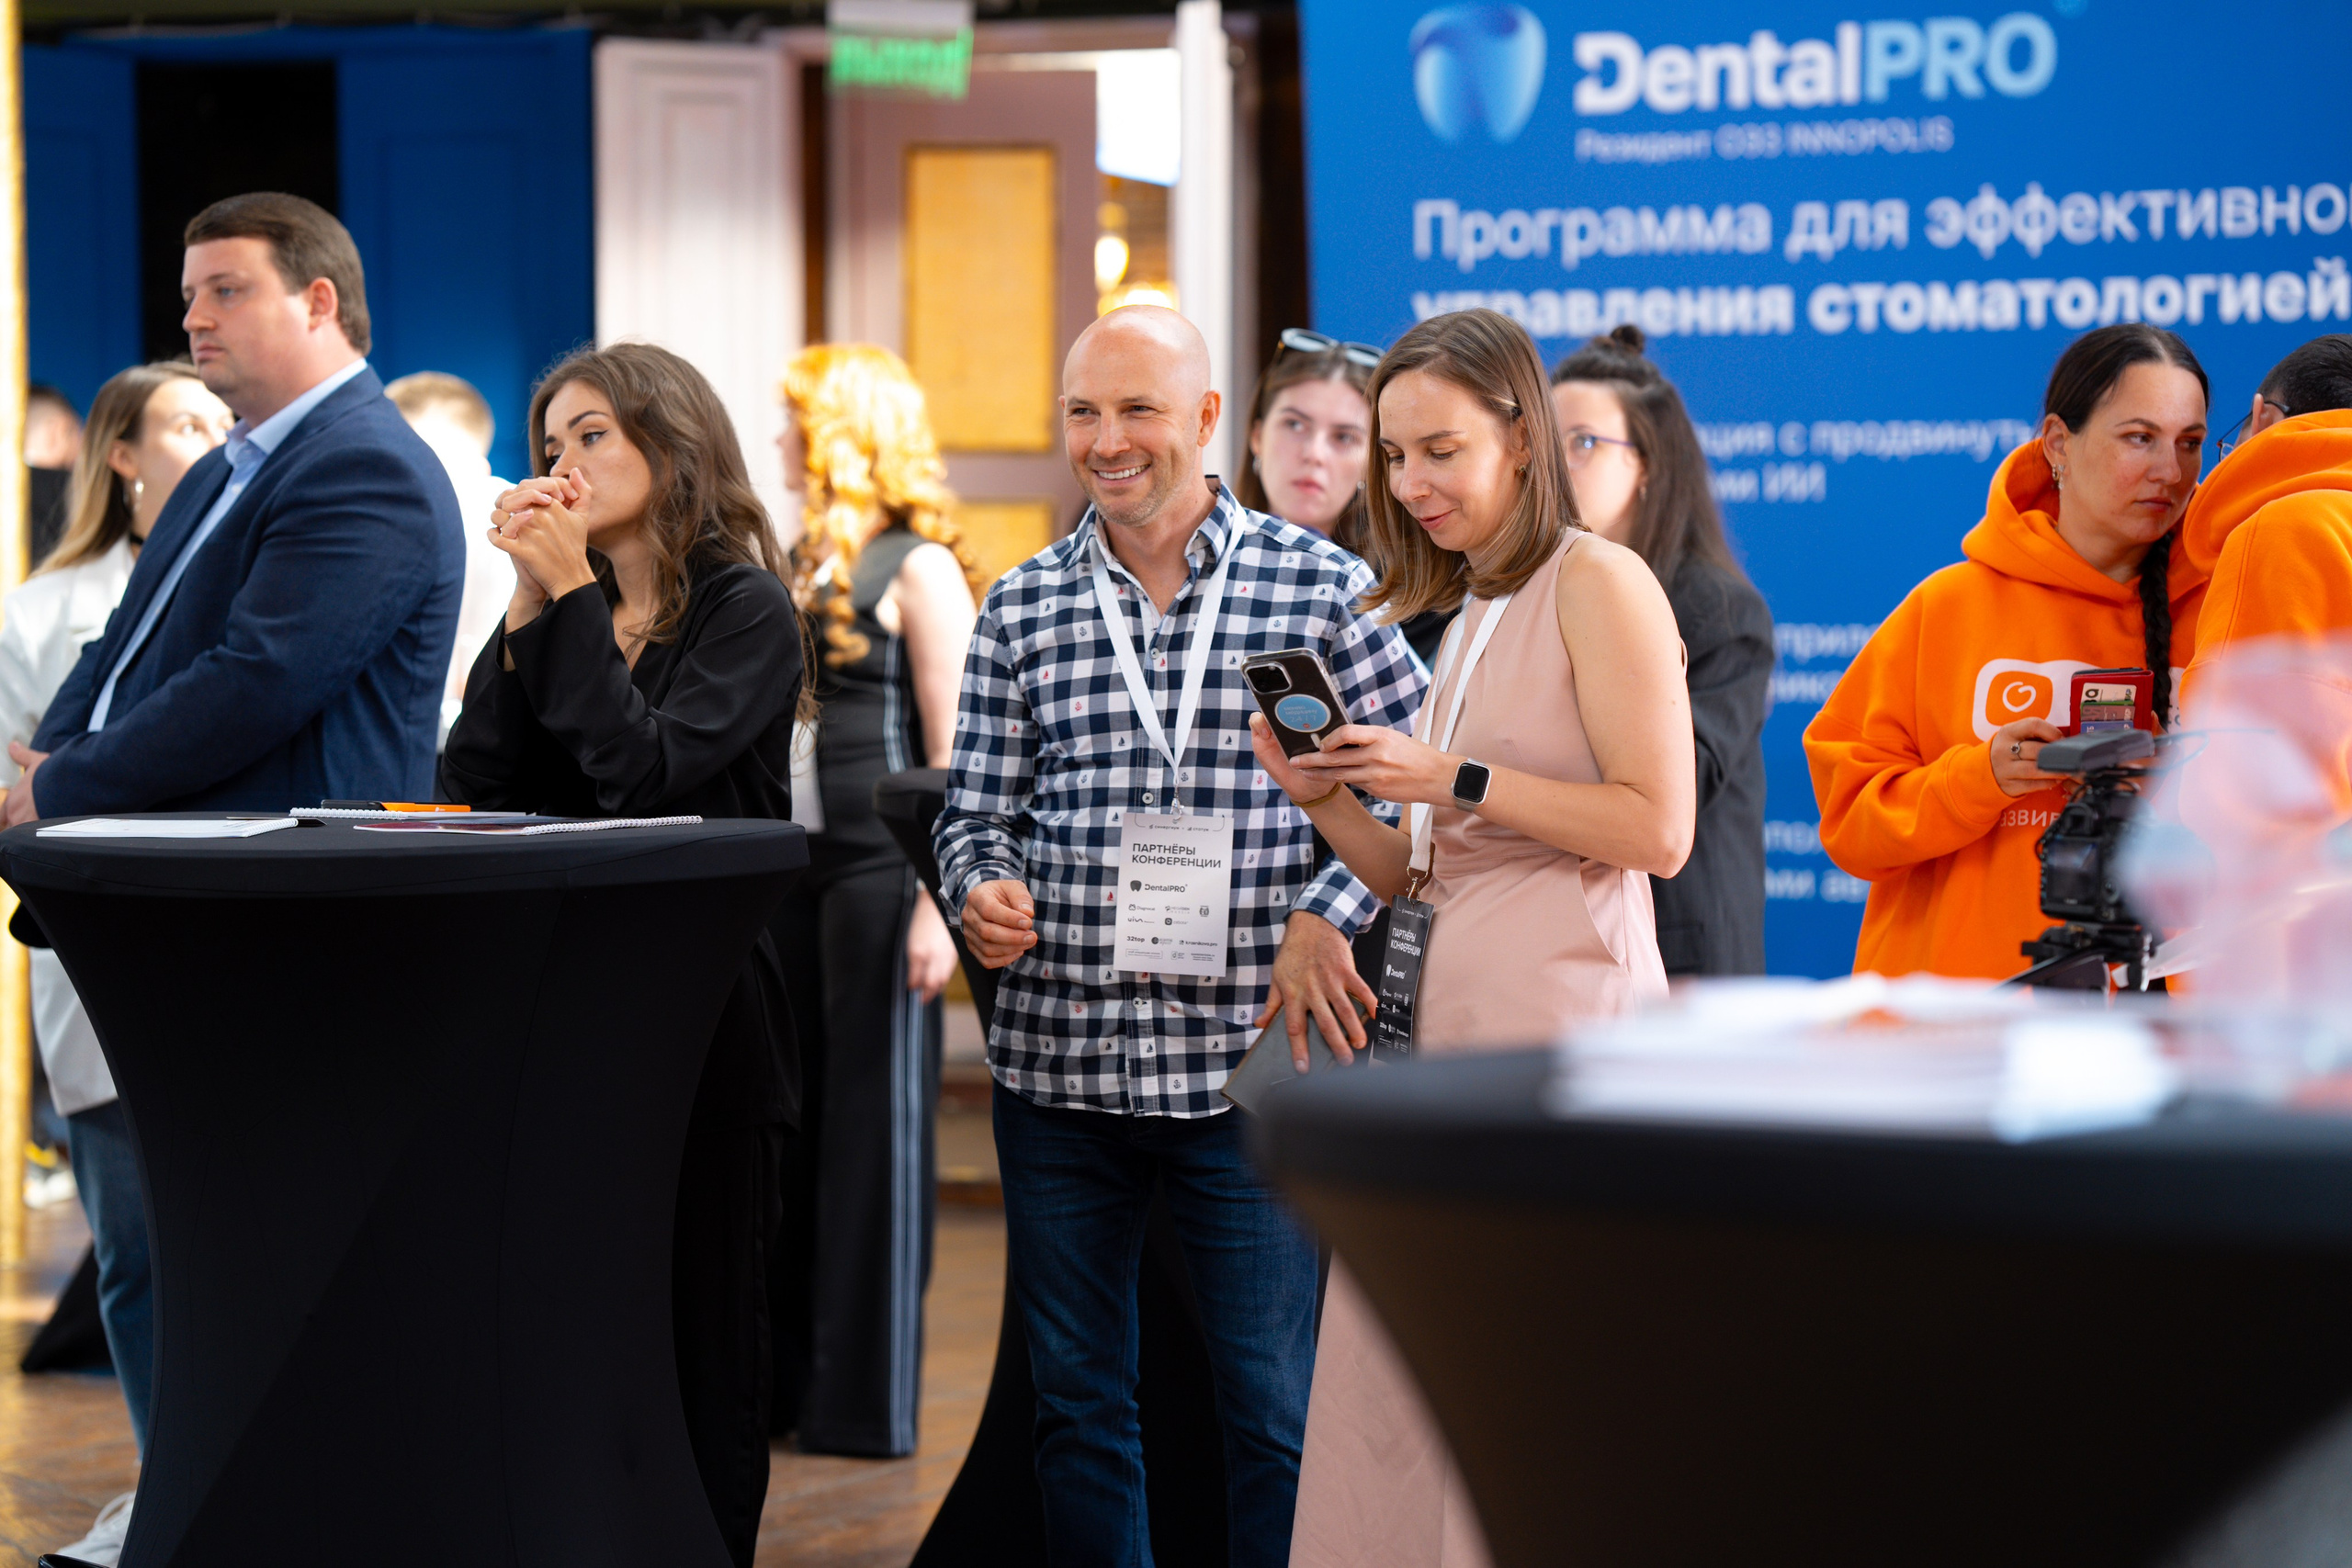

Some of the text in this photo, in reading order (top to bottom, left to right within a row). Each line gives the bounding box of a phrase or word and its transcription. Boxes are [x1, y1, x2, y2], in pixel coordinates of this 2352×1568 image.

[1573, 12, 2057, 115] DentalPRO
[1413, 182, 2352, 272] Программа для эффективно
[1808, 256, 2351, 333] стоматологией
[1133, 843, 1195, 855] ПАРТНЁРЫ
[1132, 855, 1221, 868] КОНФЕРЕНЦИИ
[1392, 927, 1416, 942] ПАРТНЁРЫ
[1390, 939, 1421, 957] КОНФЕРЕНЦИИ
